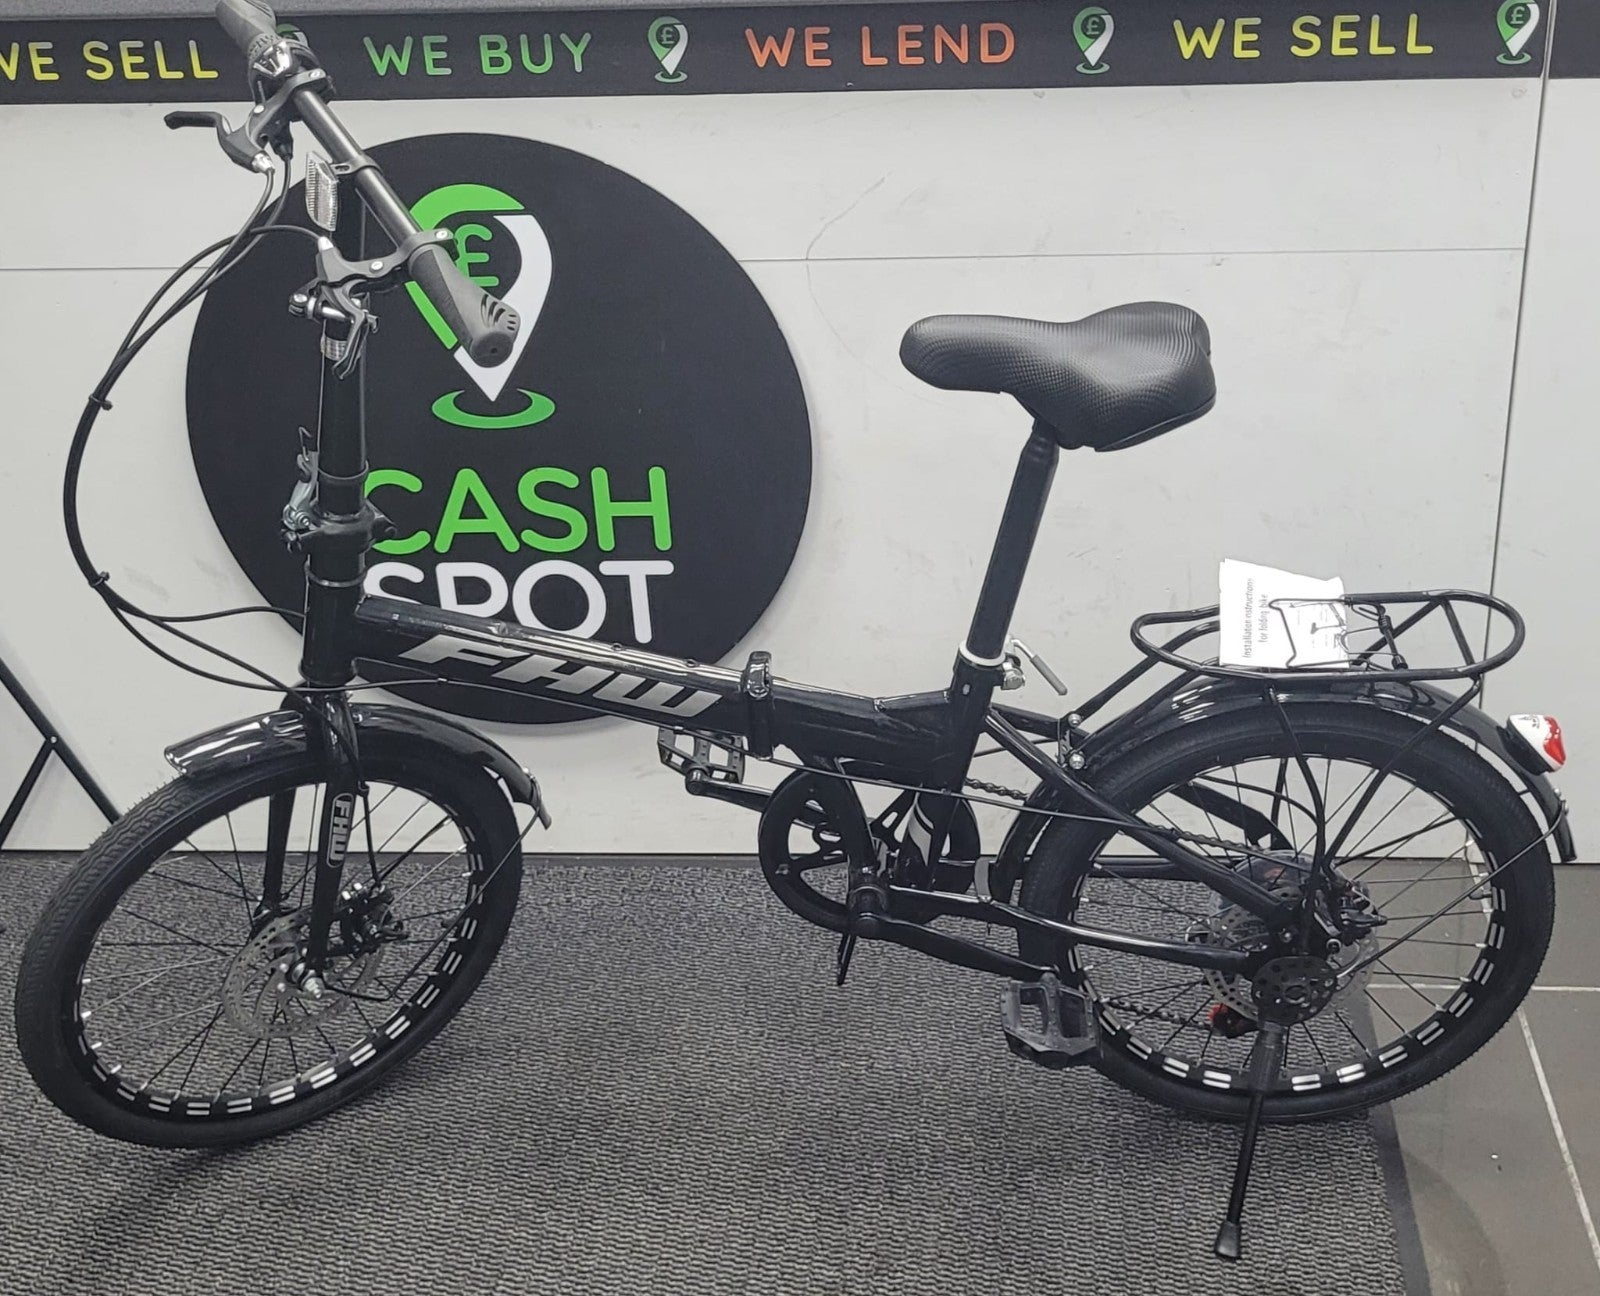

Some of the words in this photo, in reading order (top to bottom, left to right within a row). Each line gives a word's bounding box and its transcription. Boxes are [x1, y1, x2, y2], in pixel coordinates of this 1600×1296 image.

[363, 35, 453, 76] WE
[478, 32, 592, 75] BUY
[744, 26, 833, 68] WE
[861, 22, 1015, 66] LEND
[1173, 17, 1262, 60] WE
[1290, 13, 1434, 57] SELL
[82, 40, 219, 81] SELL
[364, 466, 672, 555] CASH
